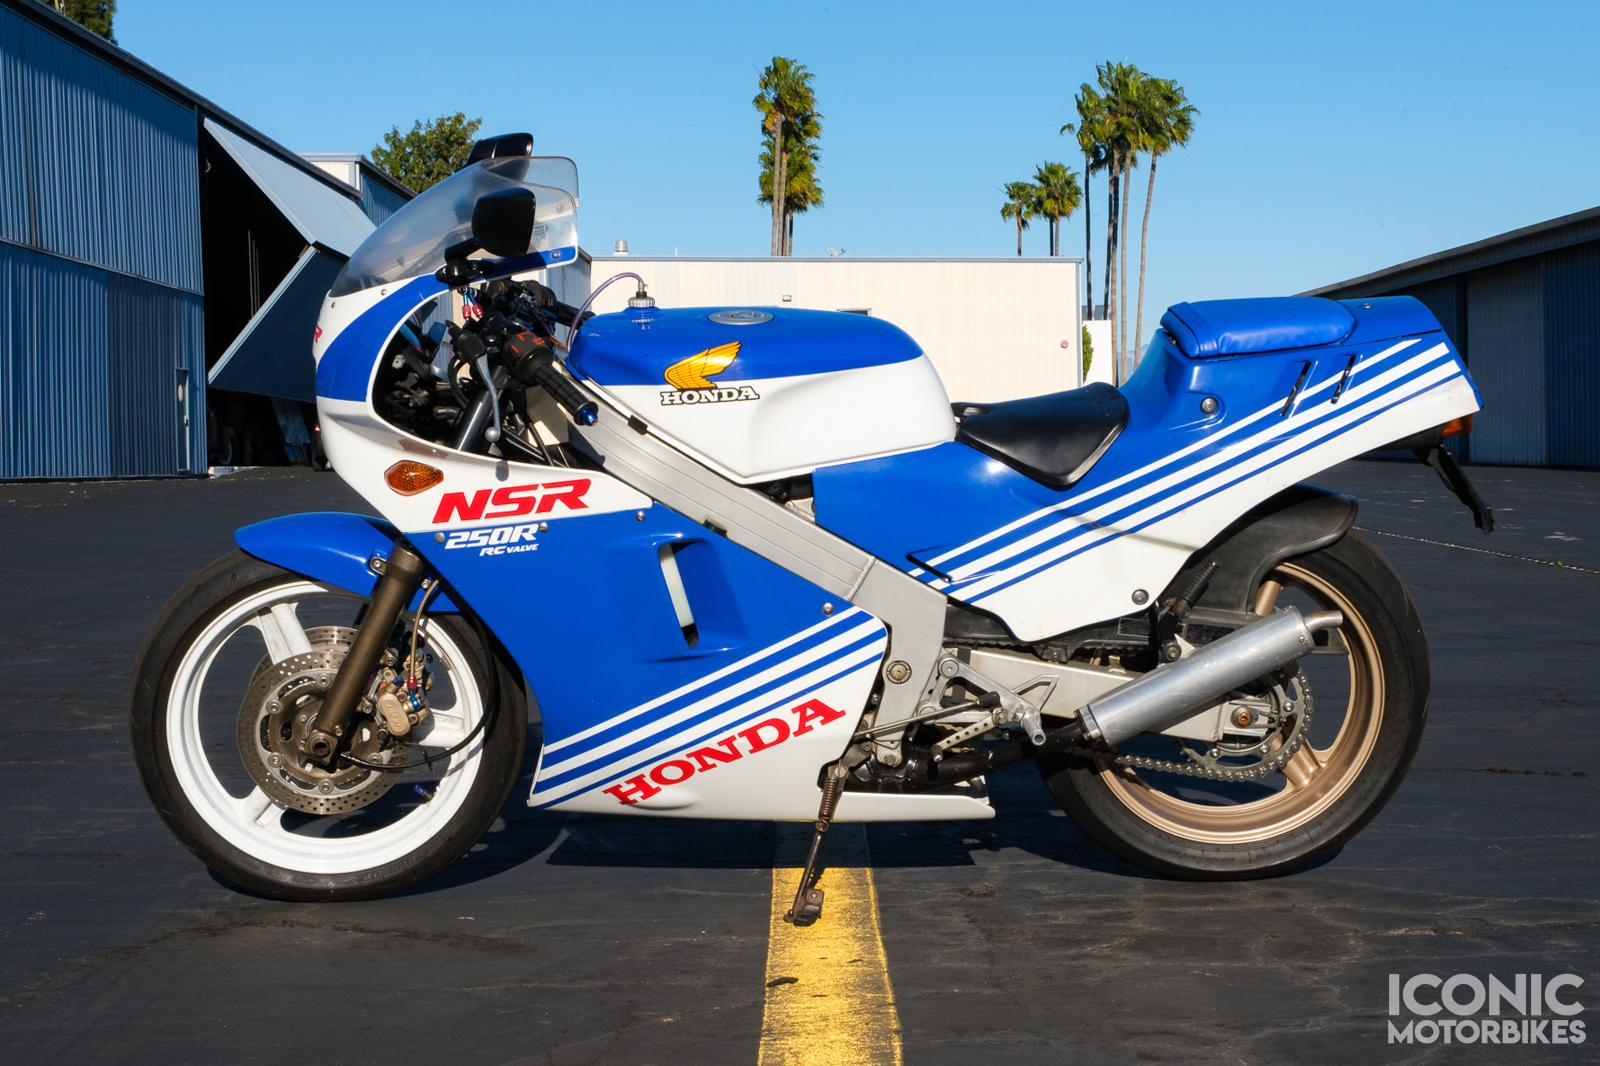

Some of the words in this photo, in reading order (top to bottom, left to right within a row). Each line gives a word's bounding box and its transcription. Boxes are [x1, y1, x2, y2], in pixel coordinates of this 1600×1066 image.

[661, 386, 760, 406] HONDA
[432, 478, 591, 523] NSR
[445, 524, 539, 550] 250R
[479, 546, 506, 557] RC
[507, 543, 539, 555] VALVE
[602, 698, 846, 805] HONDA
